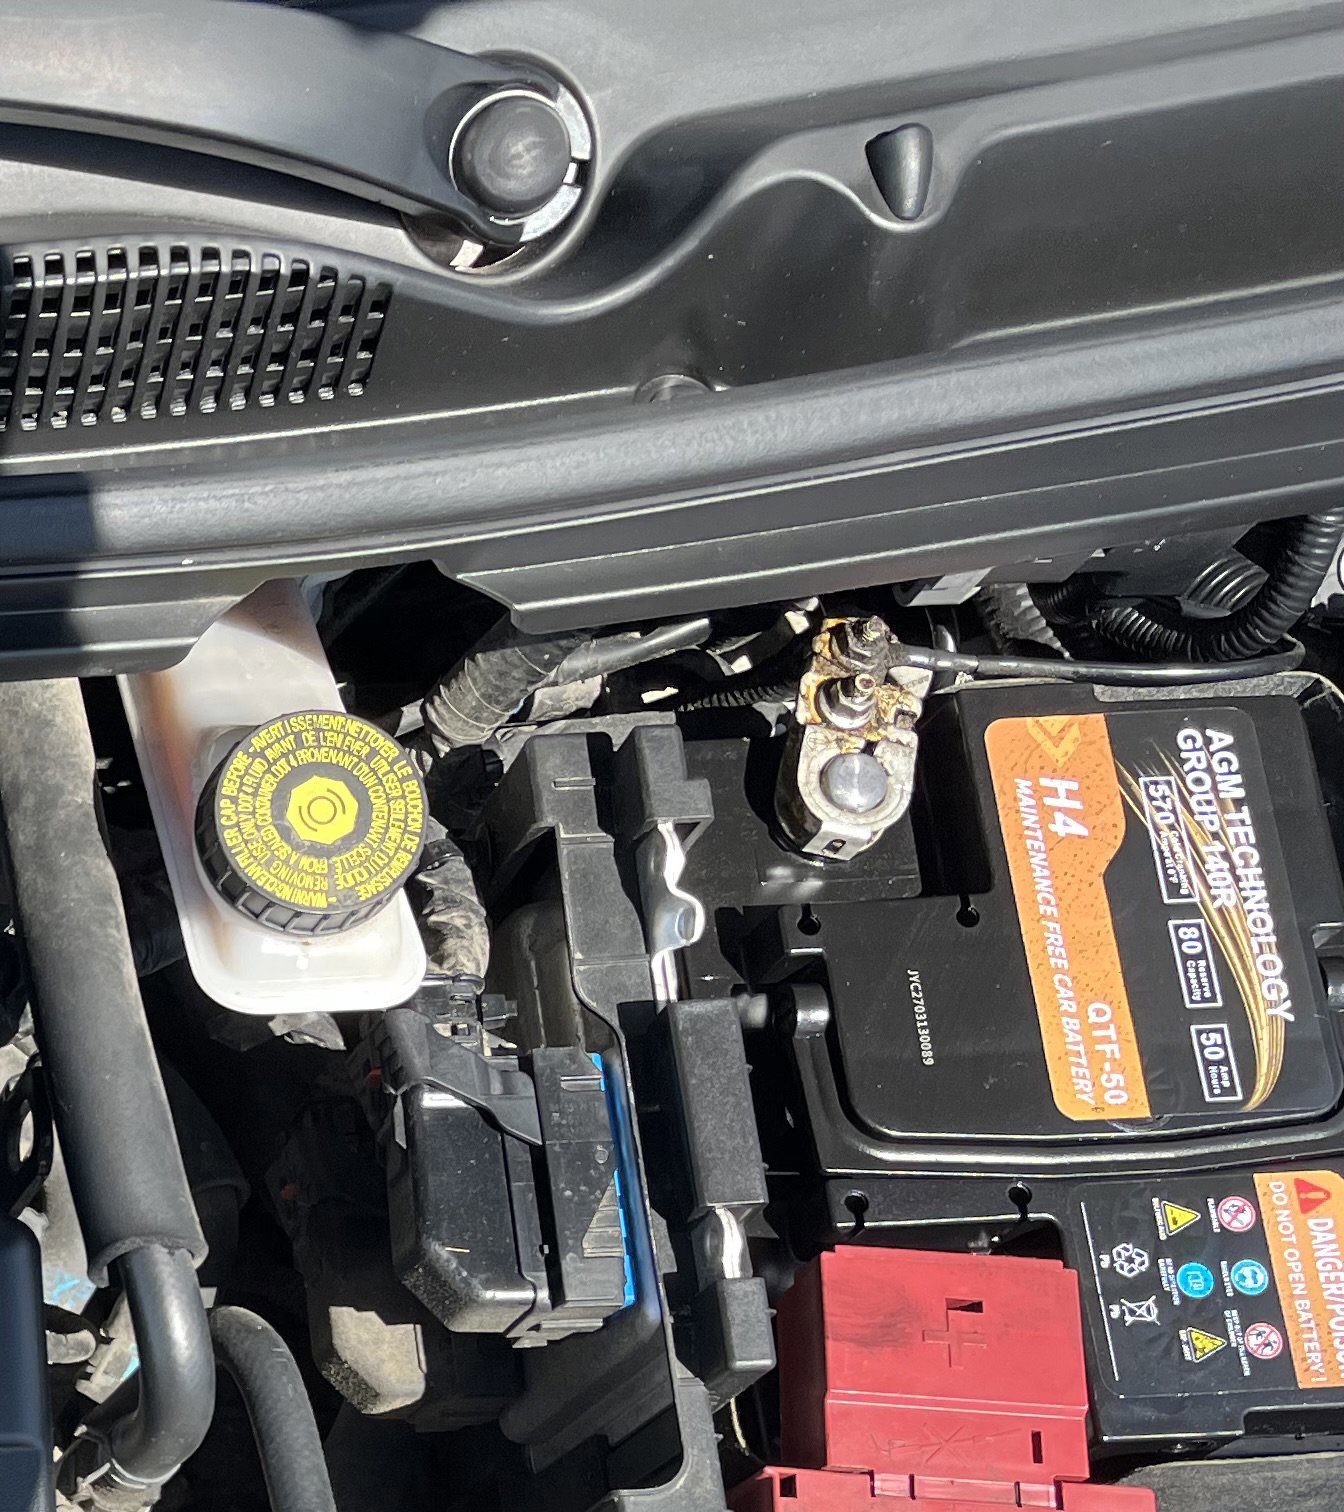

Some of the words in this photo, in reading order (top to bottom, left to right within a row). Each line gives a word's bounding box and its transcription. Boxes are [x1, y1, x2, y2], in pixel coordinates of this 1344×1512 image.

[223, 751, 255, 797] BEFORE
[1205, 728, 1246, 800] AGM
[220, 799, 239, 826] CAP
[236, 793, 255, 812] DOT
[1038, 777, 1089, 837] H4
[1148, 782, 1176, 825] 570
[1176, 727, 1220, 833] GROUP
[1202, 839, 1237, 909] 140R
[1014, 778, 1058, 918] MAINTENANCE
[1223, 805, 1295, 1022] TECHNOLOGY
[1042, 920, 1069, 970] FREE
[1178, 926, 1203, 955] 80
[1053, 973, 1077, 1013] CAR
[1186, 959, 1201, 1001] Capacity
[1061, 1017, 1096, 1105] BATTERY
[1087, 1002, 1129, 1105] QTF-50
[1200, 1032, 1225, 1060] 50
[1208, 1064, 1221, 1096] Hours
[1220, 1065, 1230, 1088] Amp
[1269, 1181, 1288, 1204] DO
[1276, 1212, 1297, 1245] NOT
[1283, 1248, 1307, 1295] OPEN
